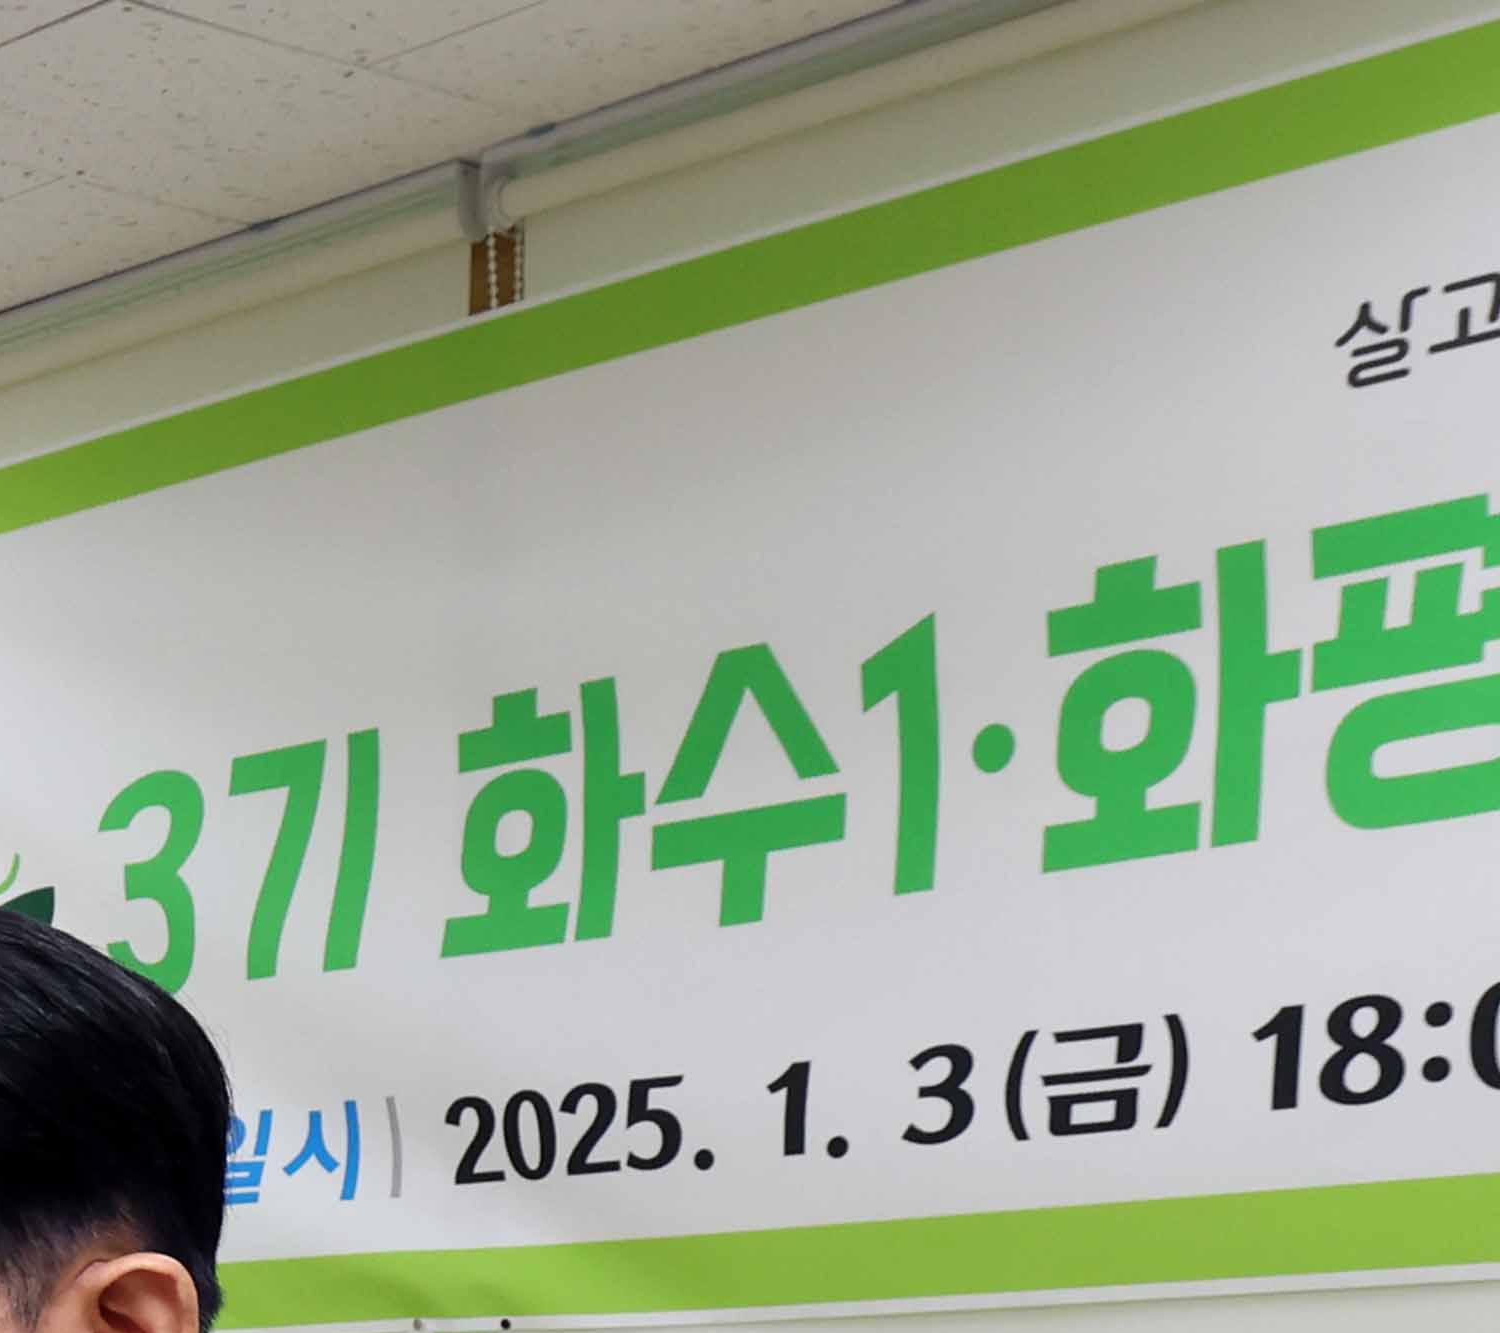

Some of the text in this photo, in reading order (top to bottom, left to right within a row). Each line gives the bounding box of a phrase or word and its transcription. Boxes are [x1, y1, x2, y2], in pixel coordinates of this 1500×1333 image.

[1334, 272, 1500, 389] 살고
[98, 727, 380, 998] 3기
[224, 1099, 361, 1206] 일시
[443, 1073, 715, 1186] 2025.
[766, 1060, 849, 1160] 1.
